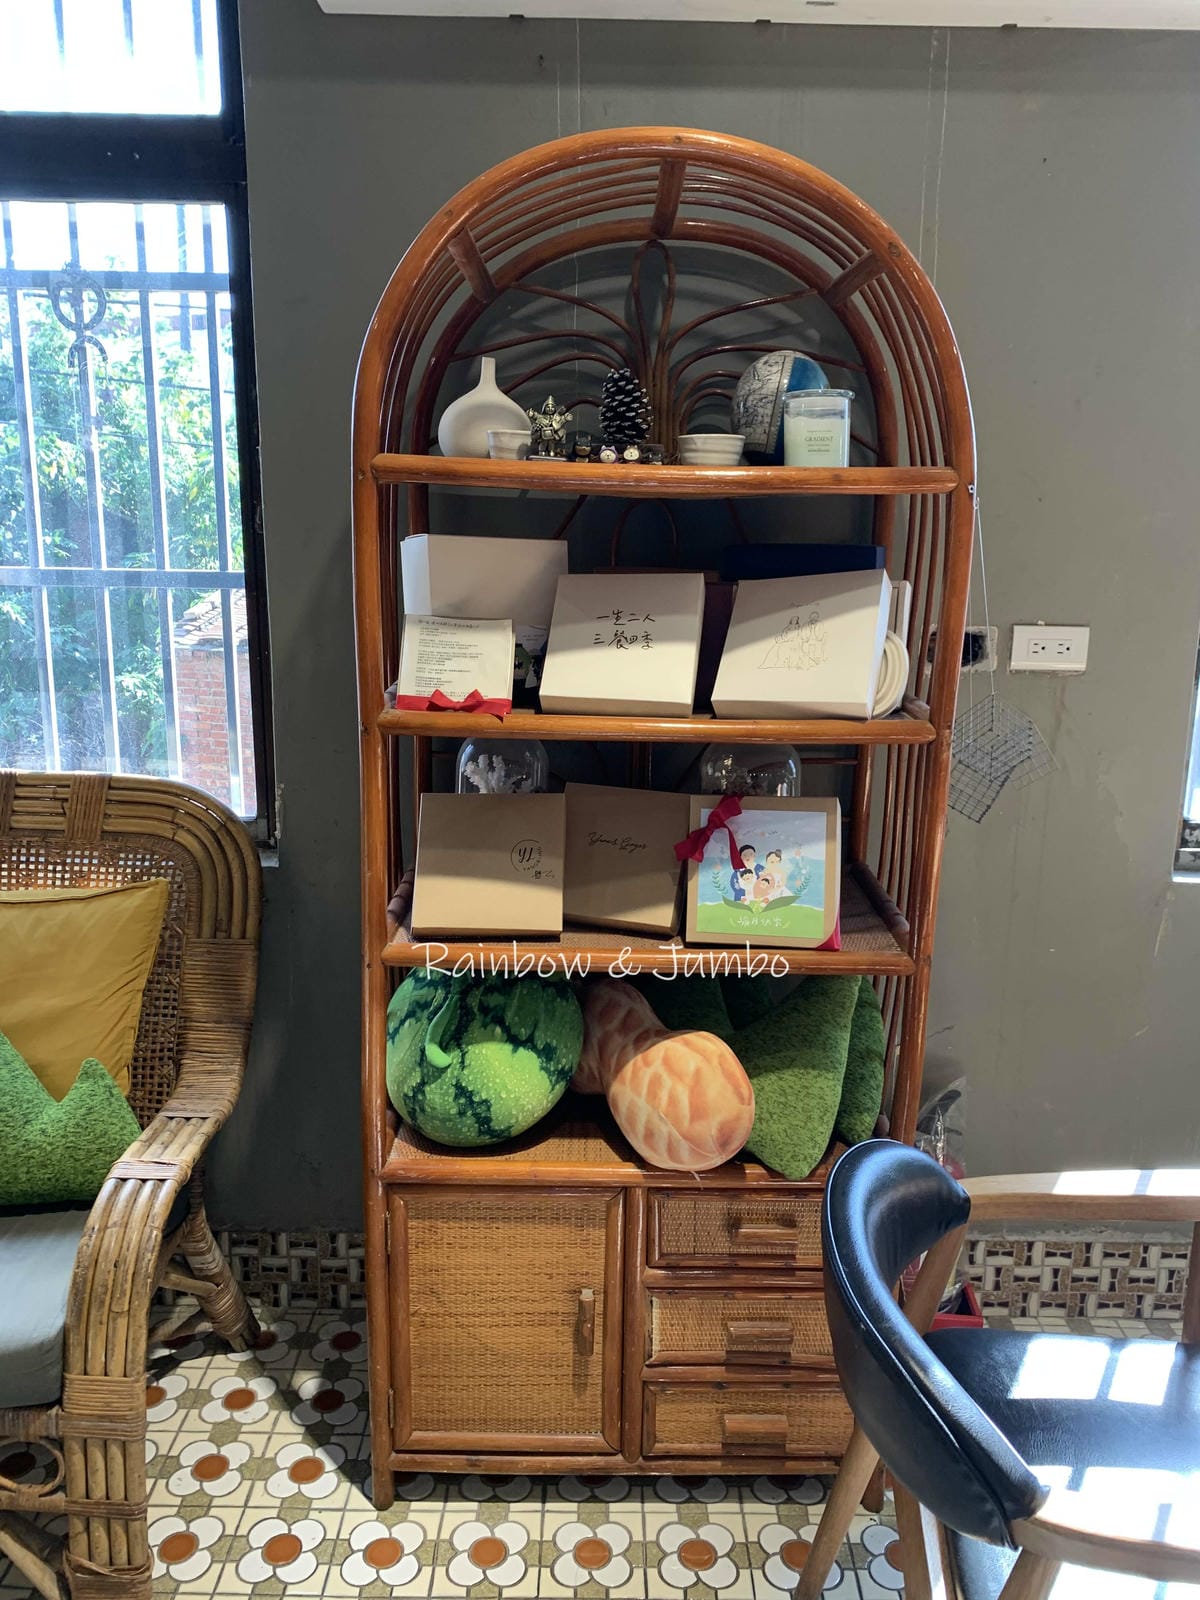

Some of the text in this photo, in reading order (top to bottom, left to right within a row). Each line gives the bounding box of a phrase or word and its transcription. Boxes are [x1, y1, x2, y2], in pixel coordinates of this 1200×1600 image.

[596, 609, 656, 626] 一生二人
[592, 629, 654, 651] 三餐四季
